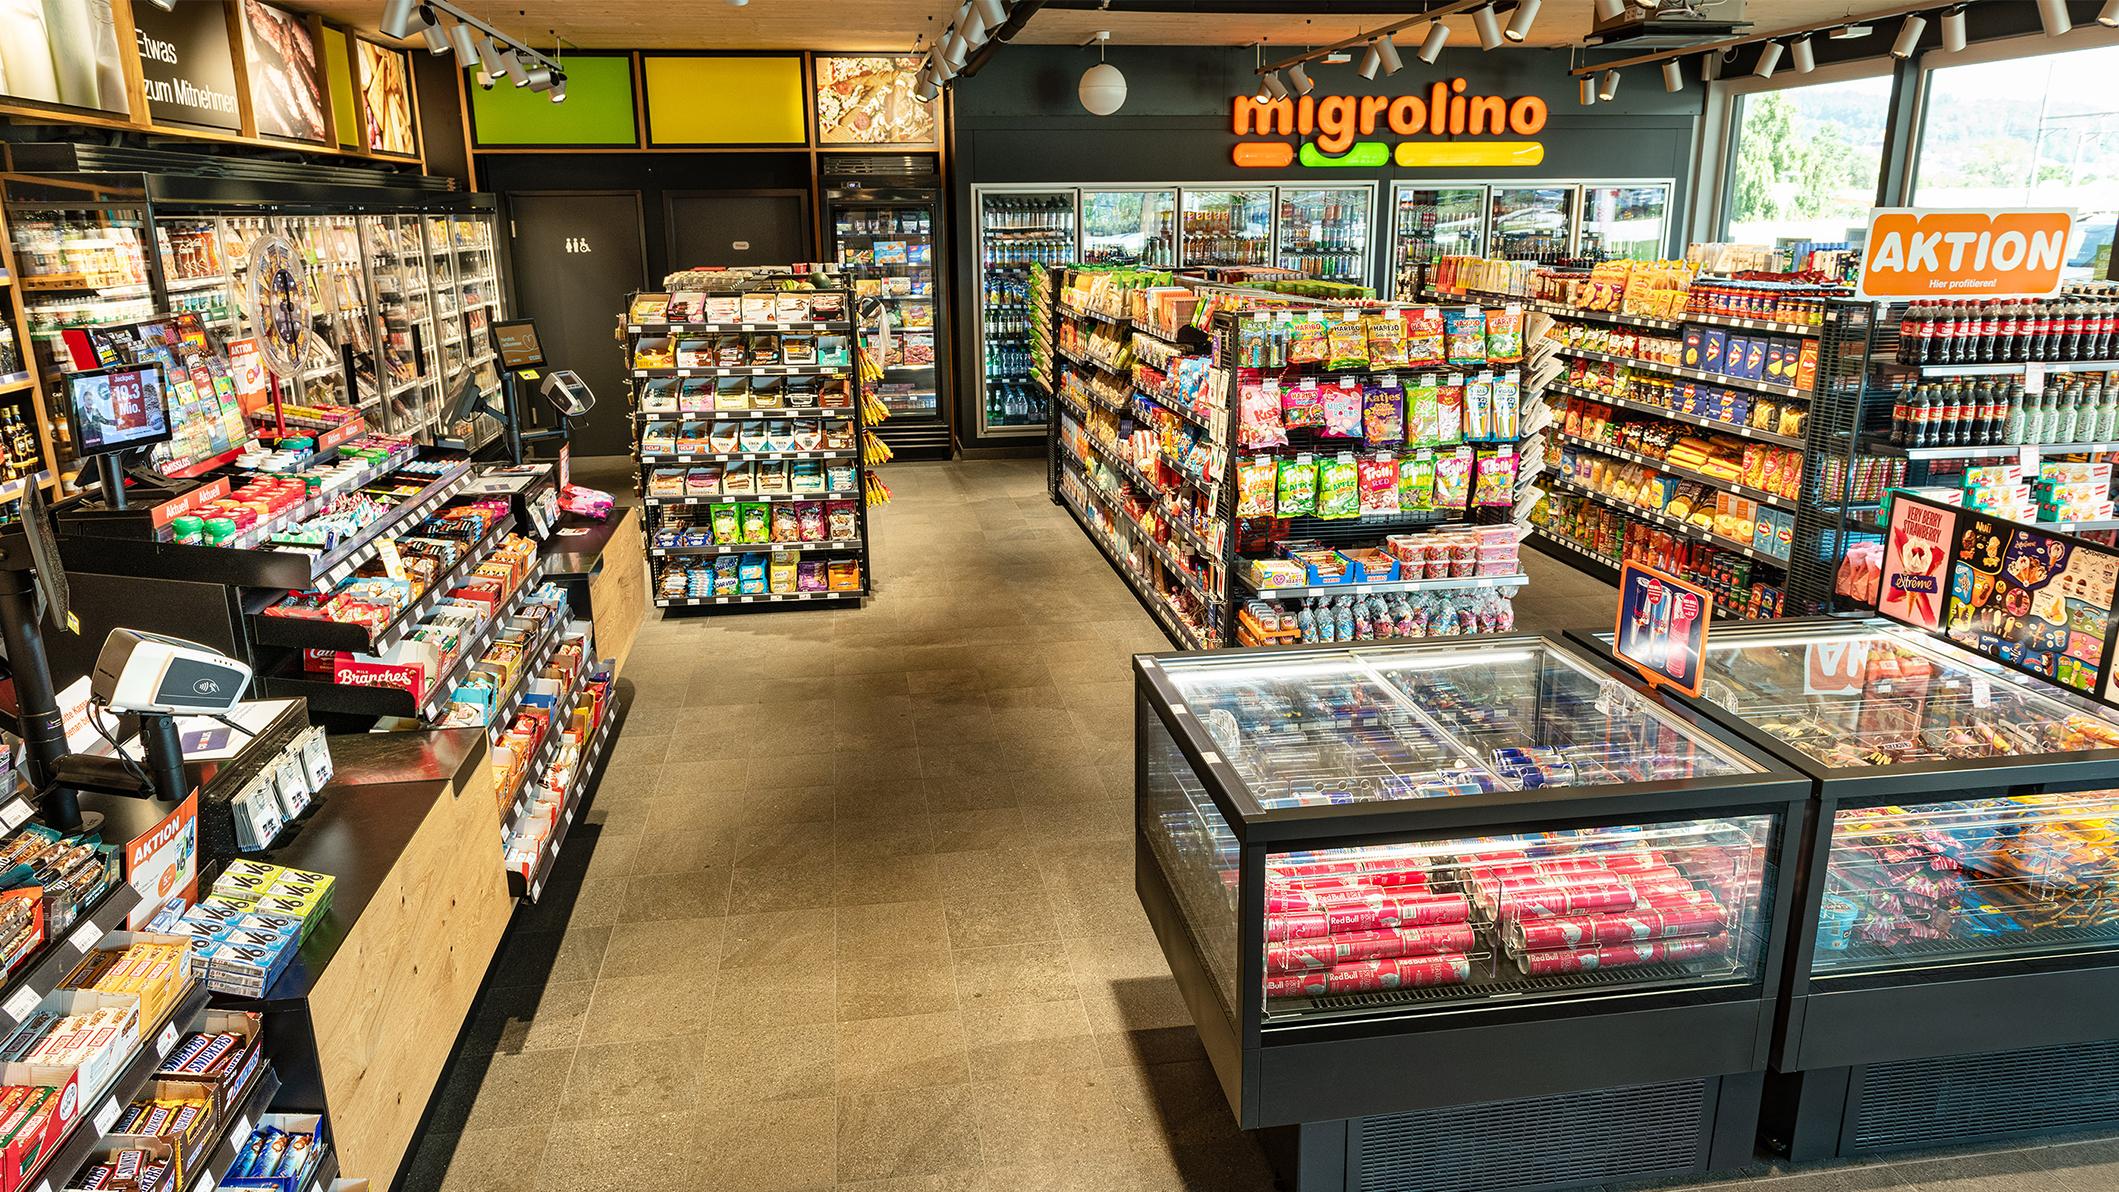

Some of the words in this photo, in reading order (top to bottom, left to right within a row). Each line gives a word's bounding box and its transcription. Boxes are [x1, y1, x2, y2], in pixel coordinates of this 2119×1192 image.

[135, 28, 177, 64] Etwas
[144, 79, 173, 103] zum
[173, 78, 237, 113] Mitnehmen
[1233, 77, 1547, 153] migrolino
[1871, 230, 2064, 272] AKTION
[1929, 279, 1947, 288] Hier
[1949, 279, 1997, 289] profitieren!
[1366, 392, 1401, 403] Katjes
[120, 403, 141, 416] Mio.
[161, 457, 191, 475] SWISSLOS
[1364, 465, 1393, 481] Trolli
[1372, 478, 1390, 487] RED
[199, 484, 220, 504] Aktuell
[166, 499, 189, 519] Aktuell
[1907, 505, 1922, 523] VERY
[1921, 509, 1943, 528] BERRY
[1902, 519, 1942, 543] STRAWBERRY
[1896, 572, 1933, 592] extrême
[338, 668, 412, 685] Branches
[134, 815, 180, 865] AKTION
[244, 863, 275, 876] V6
[232, 876, 263, 889] V6
[294, 872, 324, 885] V6
[284, 884, 315, 897] V6
[218, 900, 250, 913] V6
[273, 898, 304, 911] V6
[204, 908, 236, 921] V6
[1331, 916, 1344, 925] Red
[1345, 915, 1359, 923] Bull
[190, 922, 223, 936] V6
[257, 917, 289, 930] V6
[245, 931, 278, 946] V6
[232, 947, 265, 961] V6
[1531, 954, 1543, 962] Red
[1330, 972, 1343, 981] Red
[1344, 971, 1358, 979] Bull
[1269, 980, 1284, 989] Bull
[161, 1035, 207, 1072] SNICKERS
[188, 1035, 232, 1073] SNICKERS
